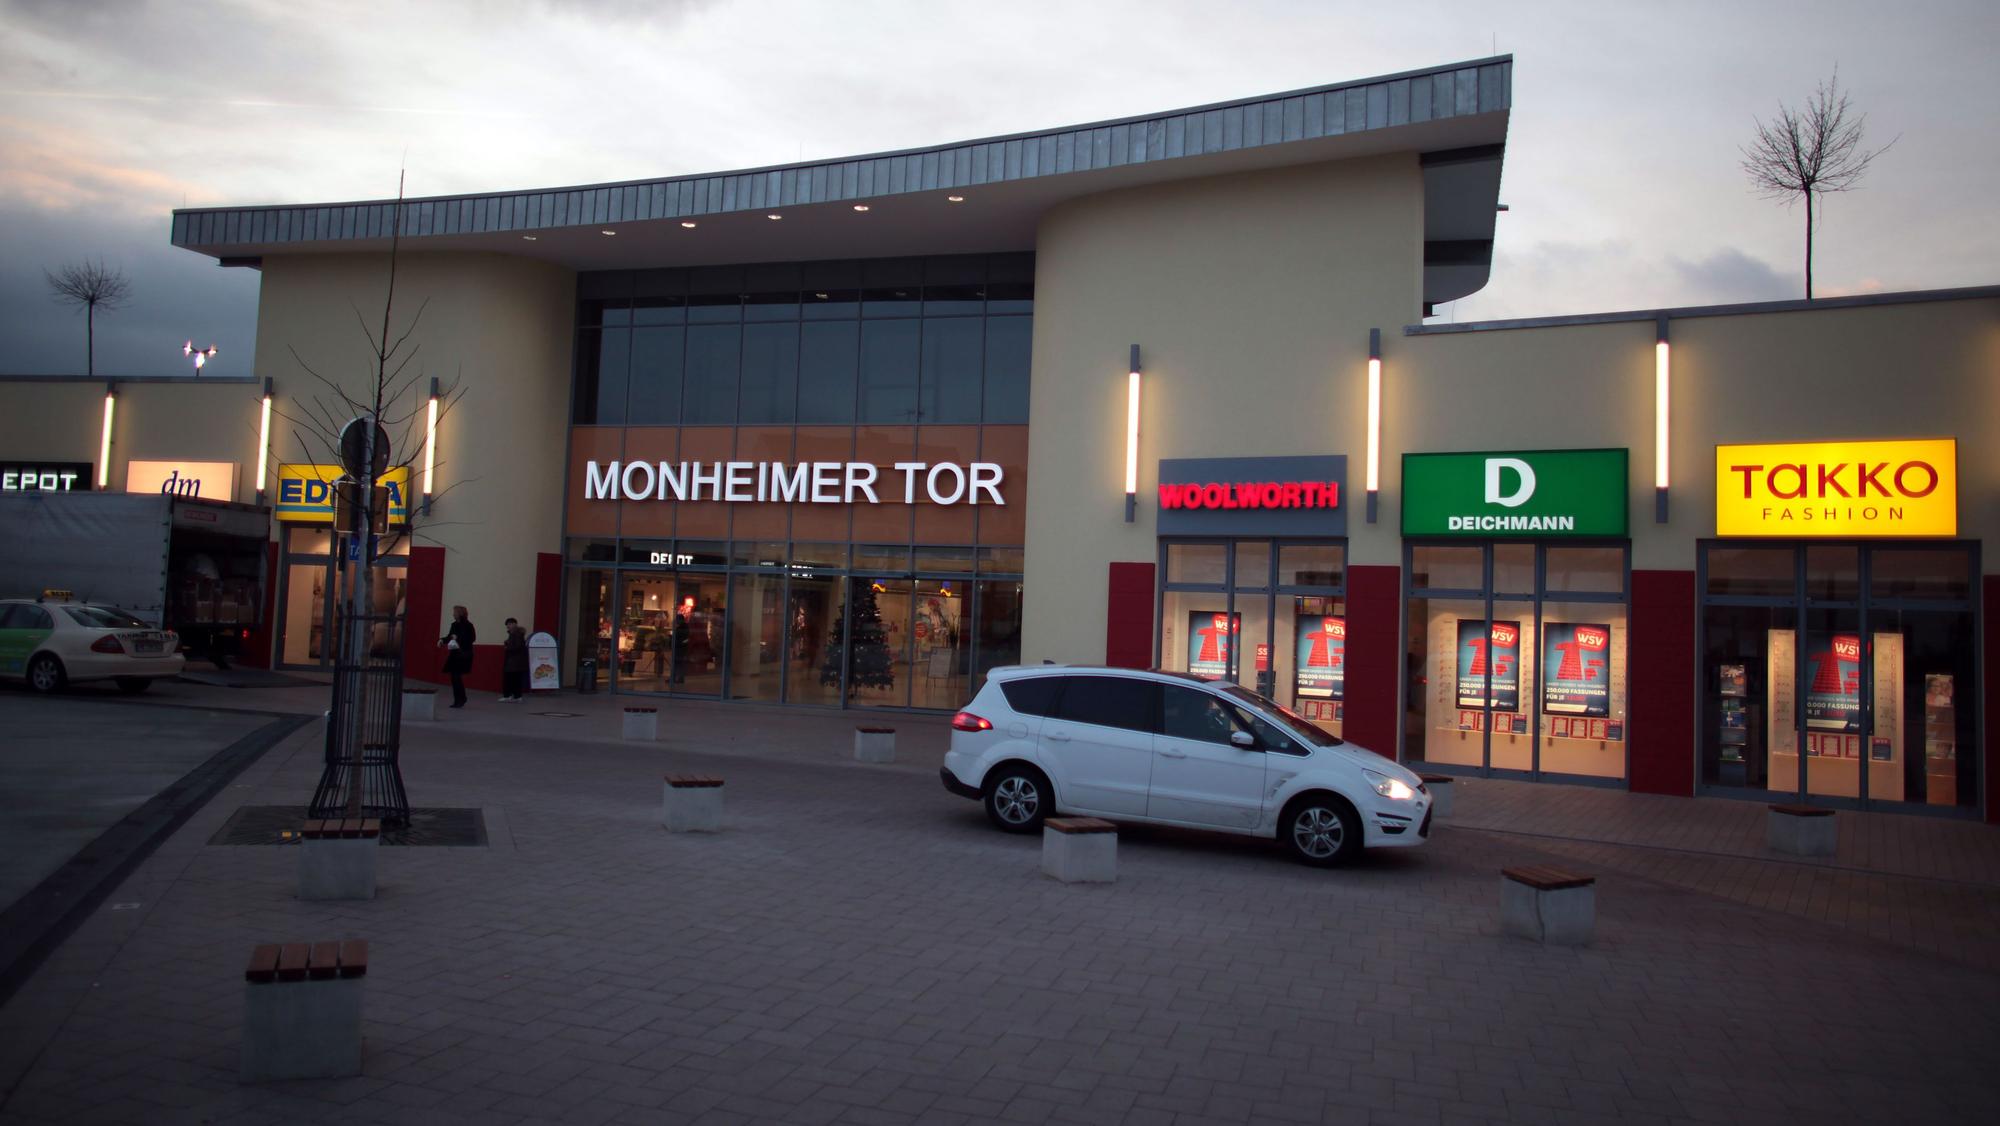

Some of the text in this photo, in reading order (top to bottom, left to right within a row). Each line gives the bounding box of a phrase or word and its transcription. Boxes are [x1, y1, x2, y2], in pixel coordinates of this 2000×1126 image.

[161, 471, 201, 498] dm
[280, 479, 402, 506] EDA
[584, 460, 1006, 507] MONHEIMER TOR
[1159, 482, 1340, 510] WOOLWORTH
[1485, 458, 1536, 507] D
[1448, 516, 1575, 530] DEICHMANN
[1762, 506, 1904, 521] FASHION
[1577, 633, 1604, 646] WSV
